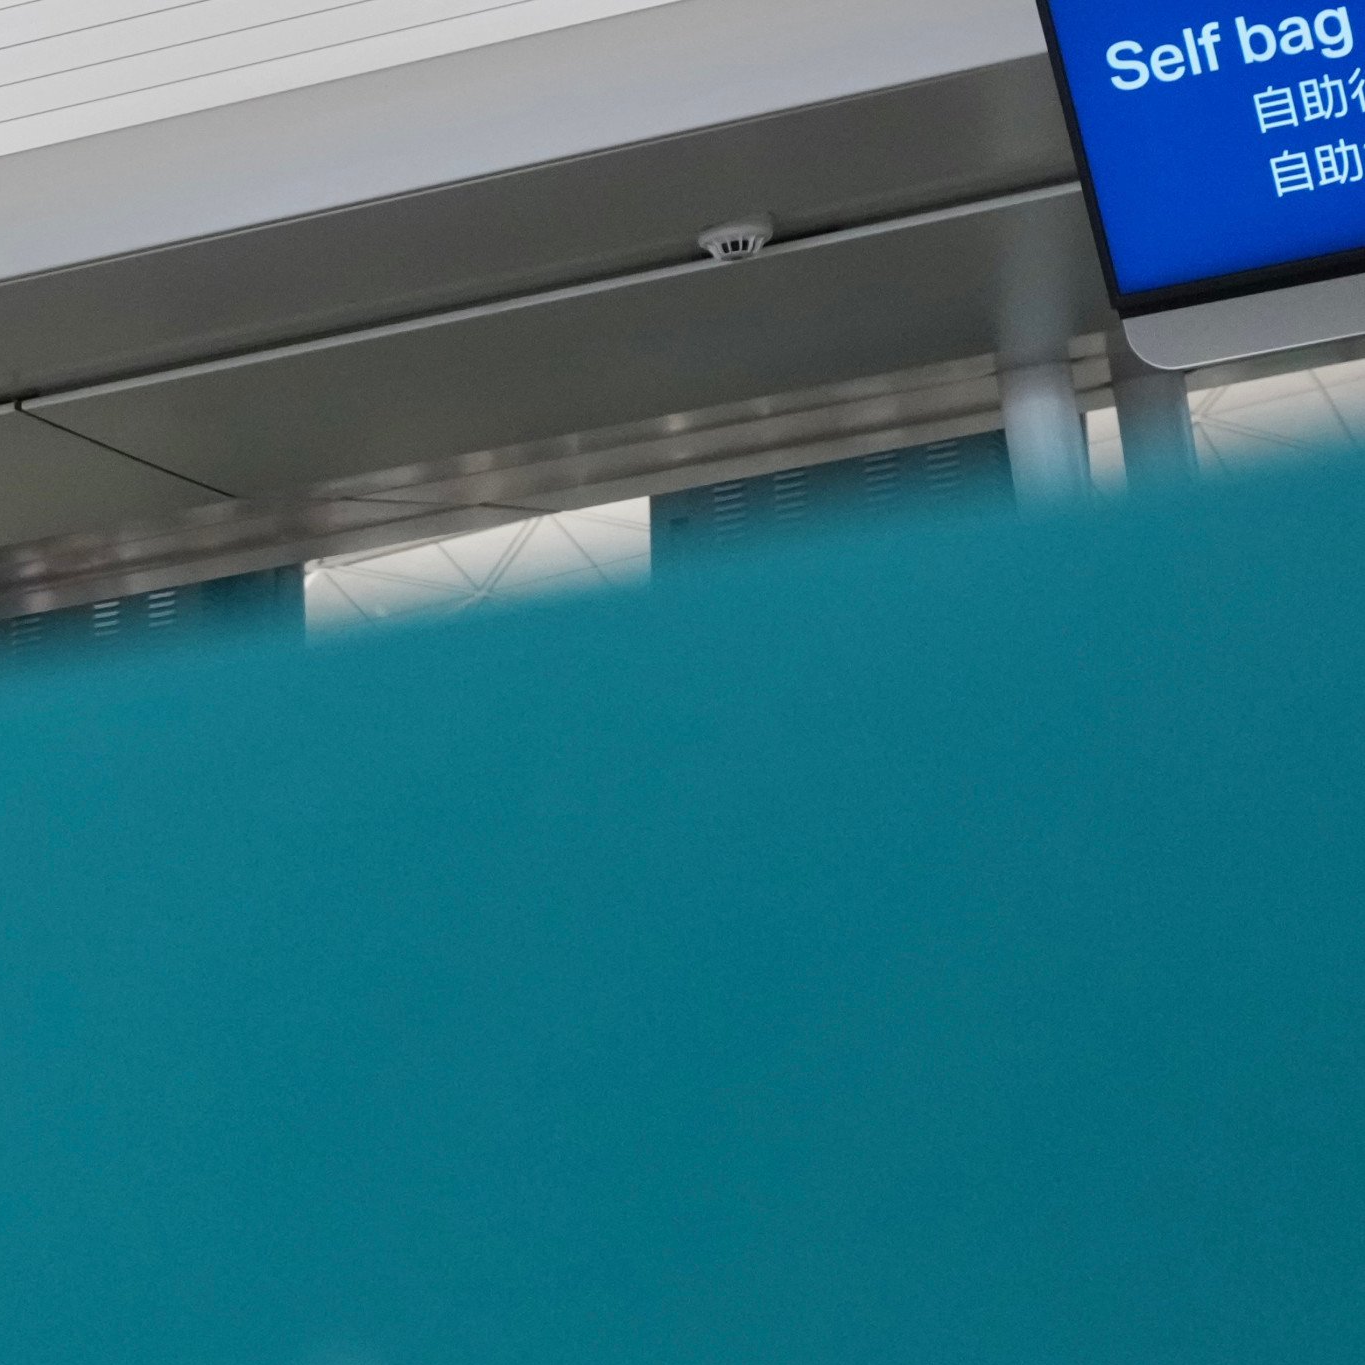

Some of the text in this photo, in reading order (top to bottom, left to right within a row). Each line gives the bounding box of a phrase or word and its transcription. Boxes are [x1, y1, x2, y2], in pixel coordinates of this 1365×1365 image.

[1106, 6, 1354, 91] Self bag
[1270, 138, 1365, 197] 自助
